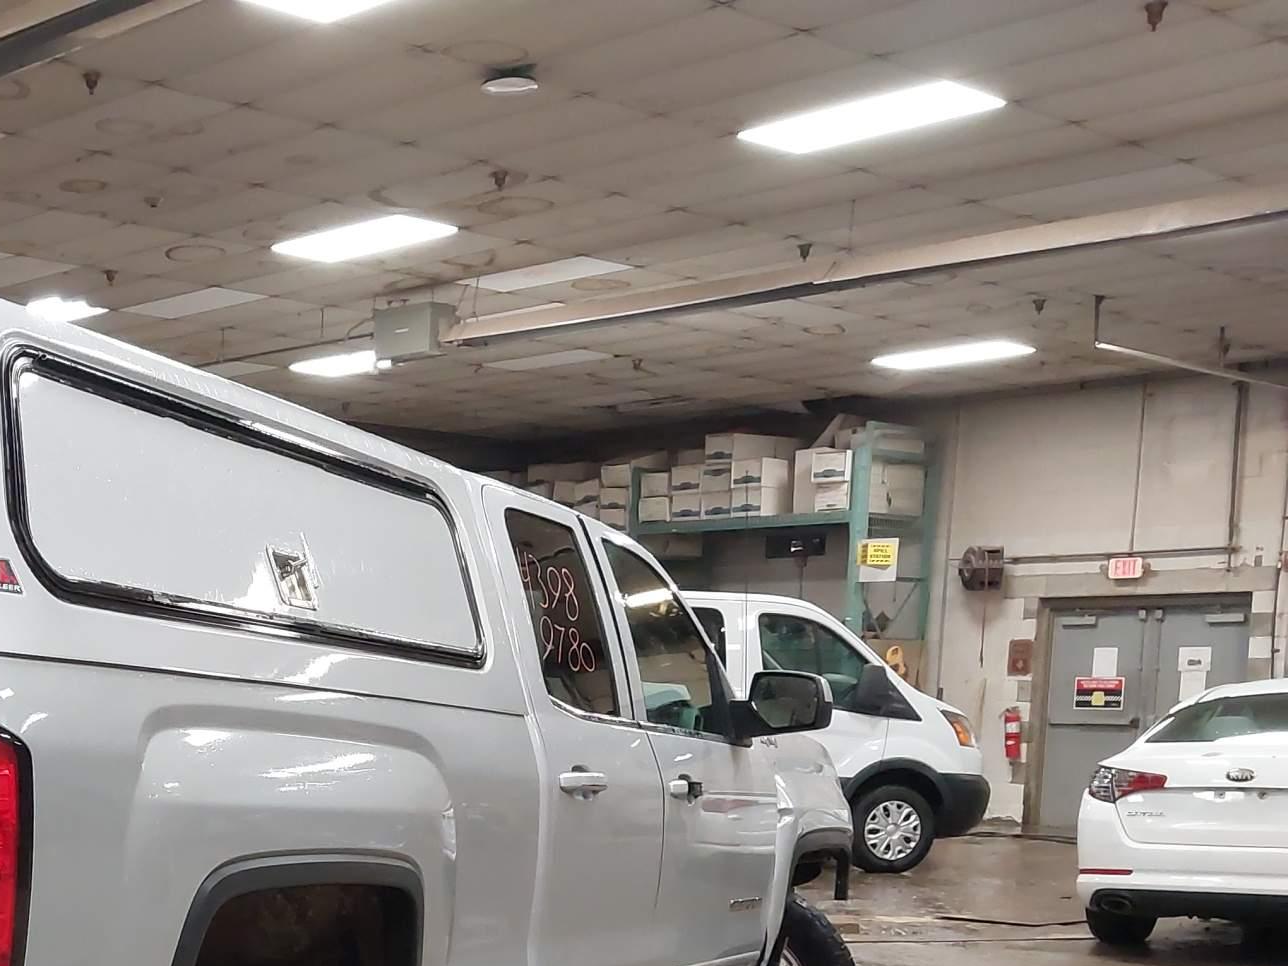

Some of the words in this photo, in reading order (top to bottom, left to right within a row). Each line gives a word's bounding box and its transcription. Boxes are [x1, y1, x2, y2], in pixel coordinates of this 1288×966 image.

[516, 546, 579, 622] 4398
[1114, 559, 1137, 577] EXIT
[539, 615, 595, 672] 9780
